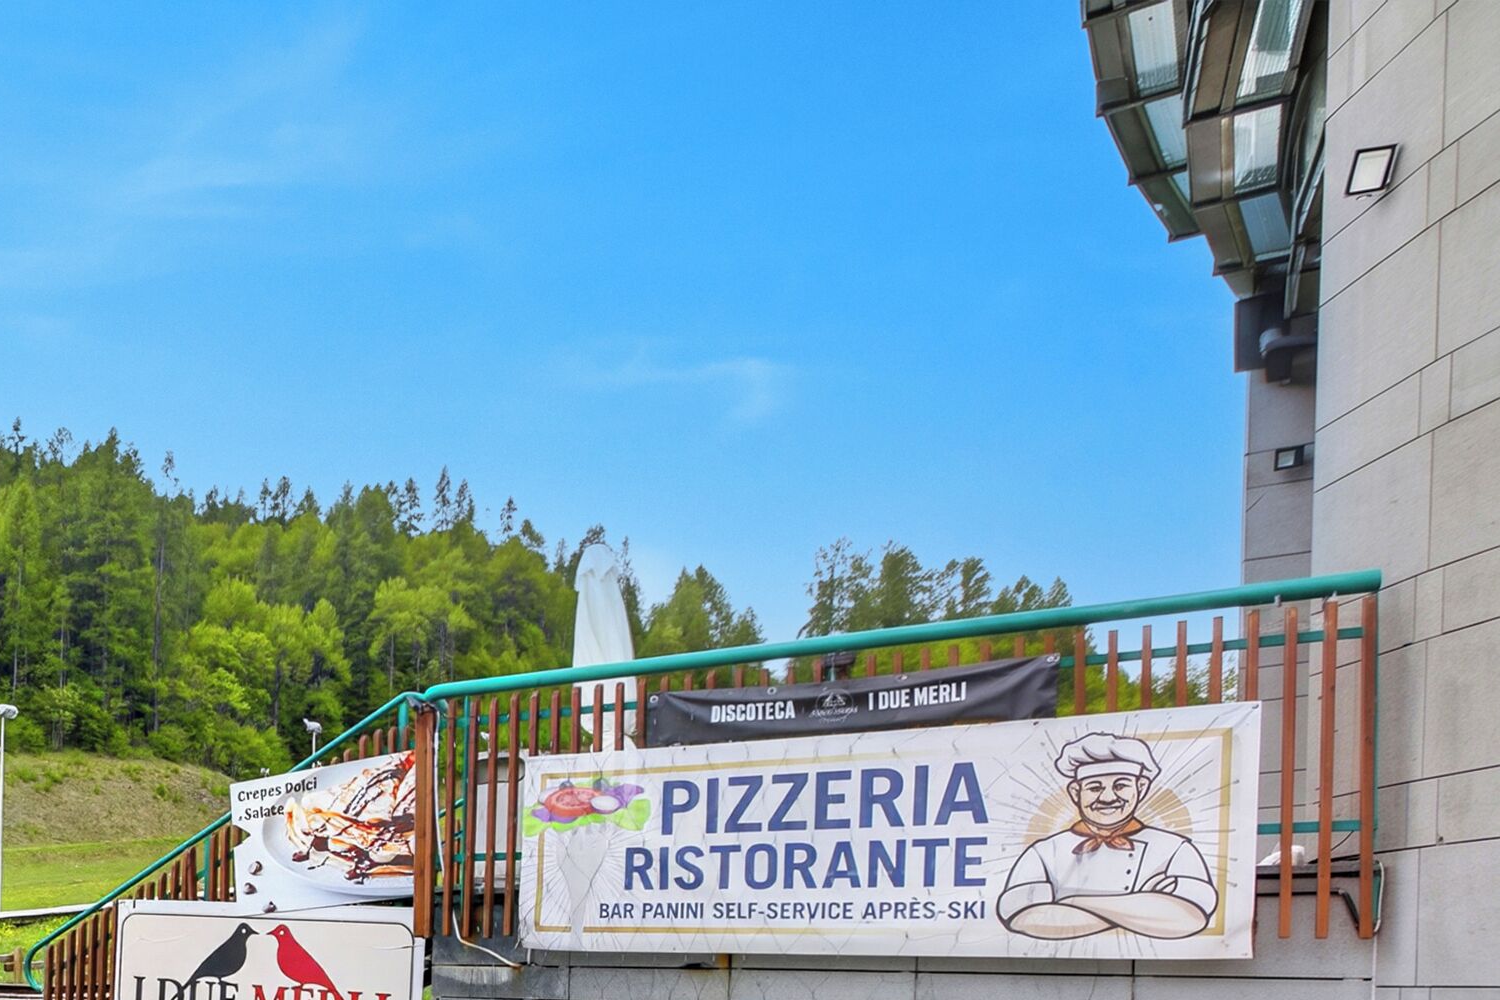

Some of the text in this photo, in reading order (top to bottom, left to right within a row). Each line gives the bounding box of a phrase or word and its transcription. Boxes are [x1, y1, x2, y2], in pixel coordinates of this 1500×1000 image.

[710, 700, 796, 723] DISCOTECA
[868, 692, 874, 711] I
[878, 688, 911, 710] DUE
[914, 682, 968, 707] MERLI
[237, 777, 317, 802] Crepes Dolci
[660, 762, 989, 835] PIZZERIA
[623, 837, 988, 890] RISTORANTE
[599, 897, 986, 920] BAR PANINI SELF-SERVICE APRÈS-SKI
